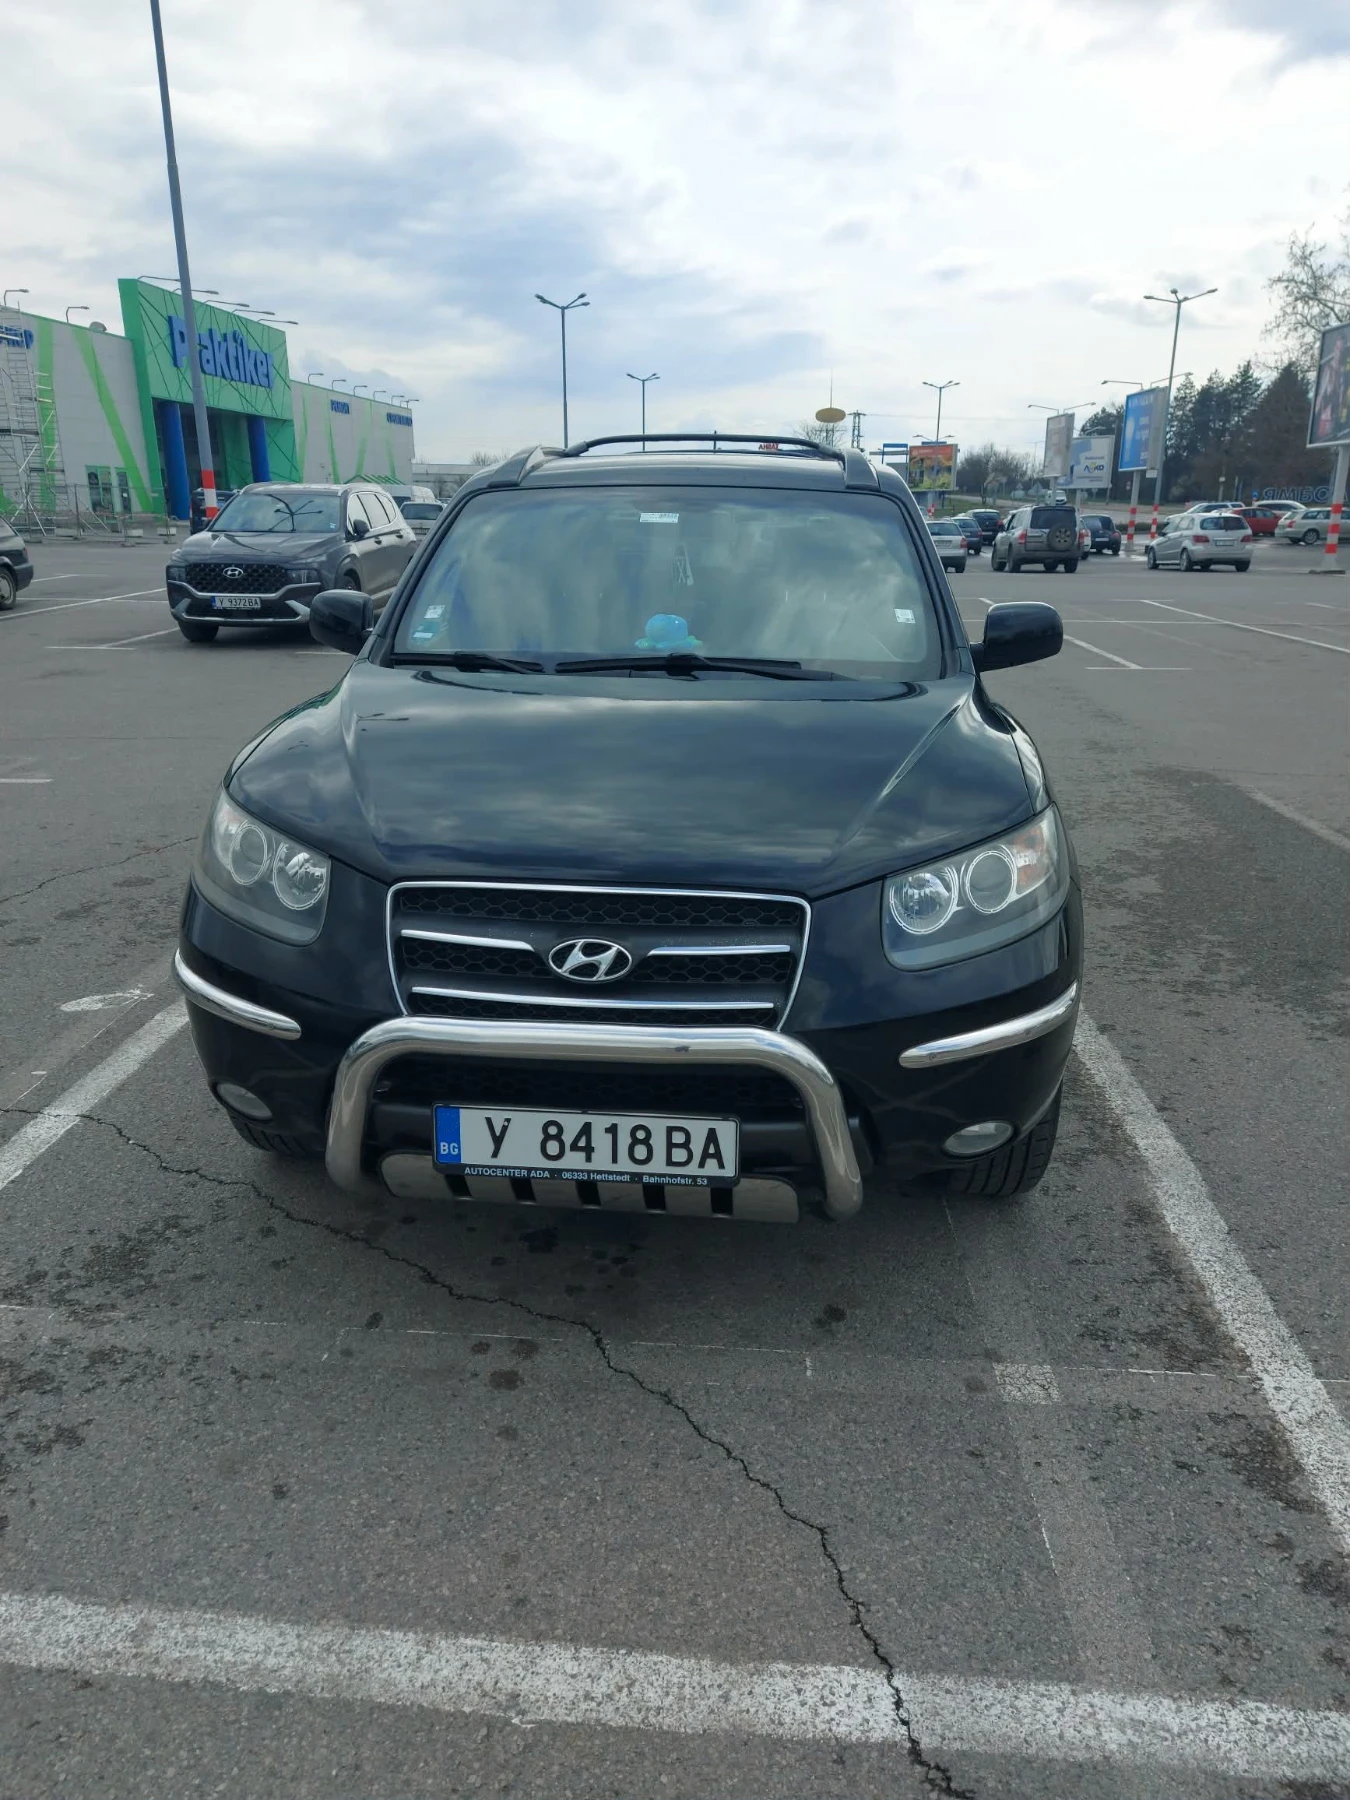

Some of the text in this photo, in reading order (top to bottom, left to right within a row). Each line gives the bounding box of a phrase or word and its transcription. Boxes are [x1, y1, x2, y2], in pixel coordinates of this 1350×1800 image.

[168, 315, 274, 389] Paktiker
[439, 1141, 459, 1156] BG
[464, 1166, 708, 1186] AUTOCENTER ADA 06333 Hettstedt Bahnhofstr. 53
